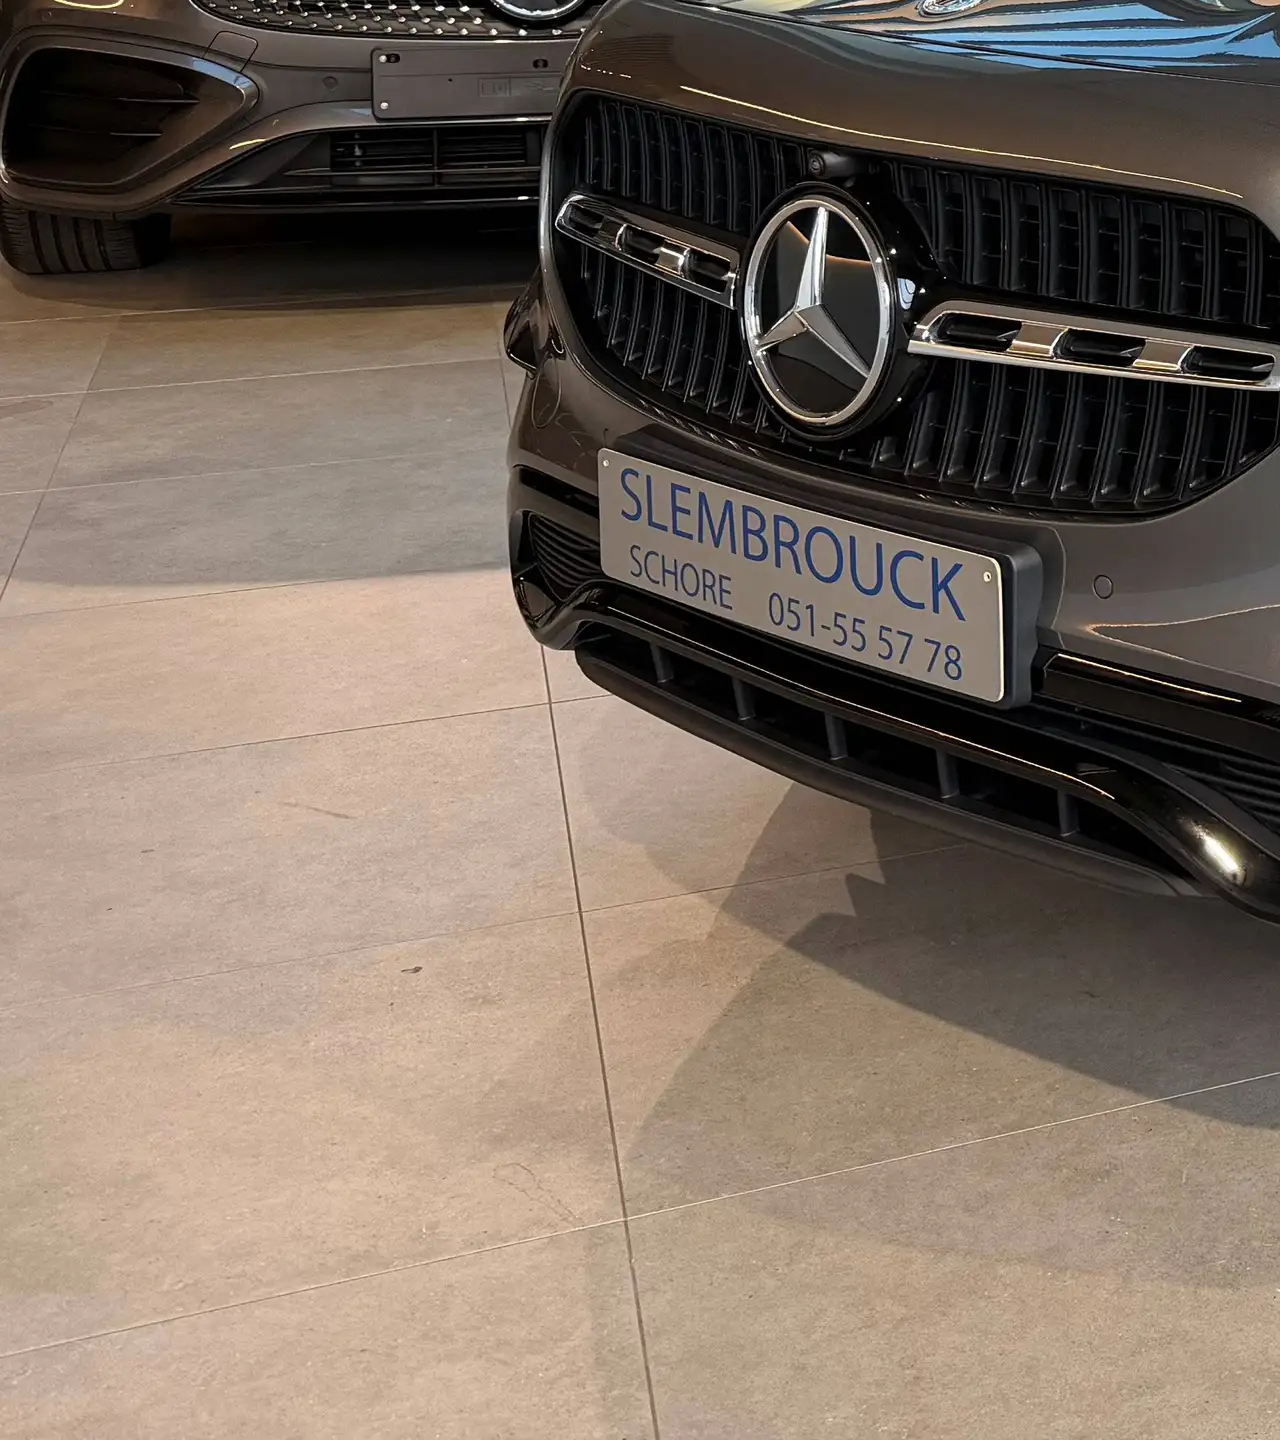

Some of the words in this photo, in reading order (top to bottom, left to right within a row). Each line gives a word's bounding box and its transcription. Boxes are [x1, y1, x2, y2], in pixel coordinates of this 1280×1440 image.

[620, 467, 967, 621] SLEMBROUCK
[629, 544, 733, 610] SCHORE
[768, 592, 867, 652] 051-55
[877, 625, 914, 665] 57
[924, 638, 963, 681] 78
